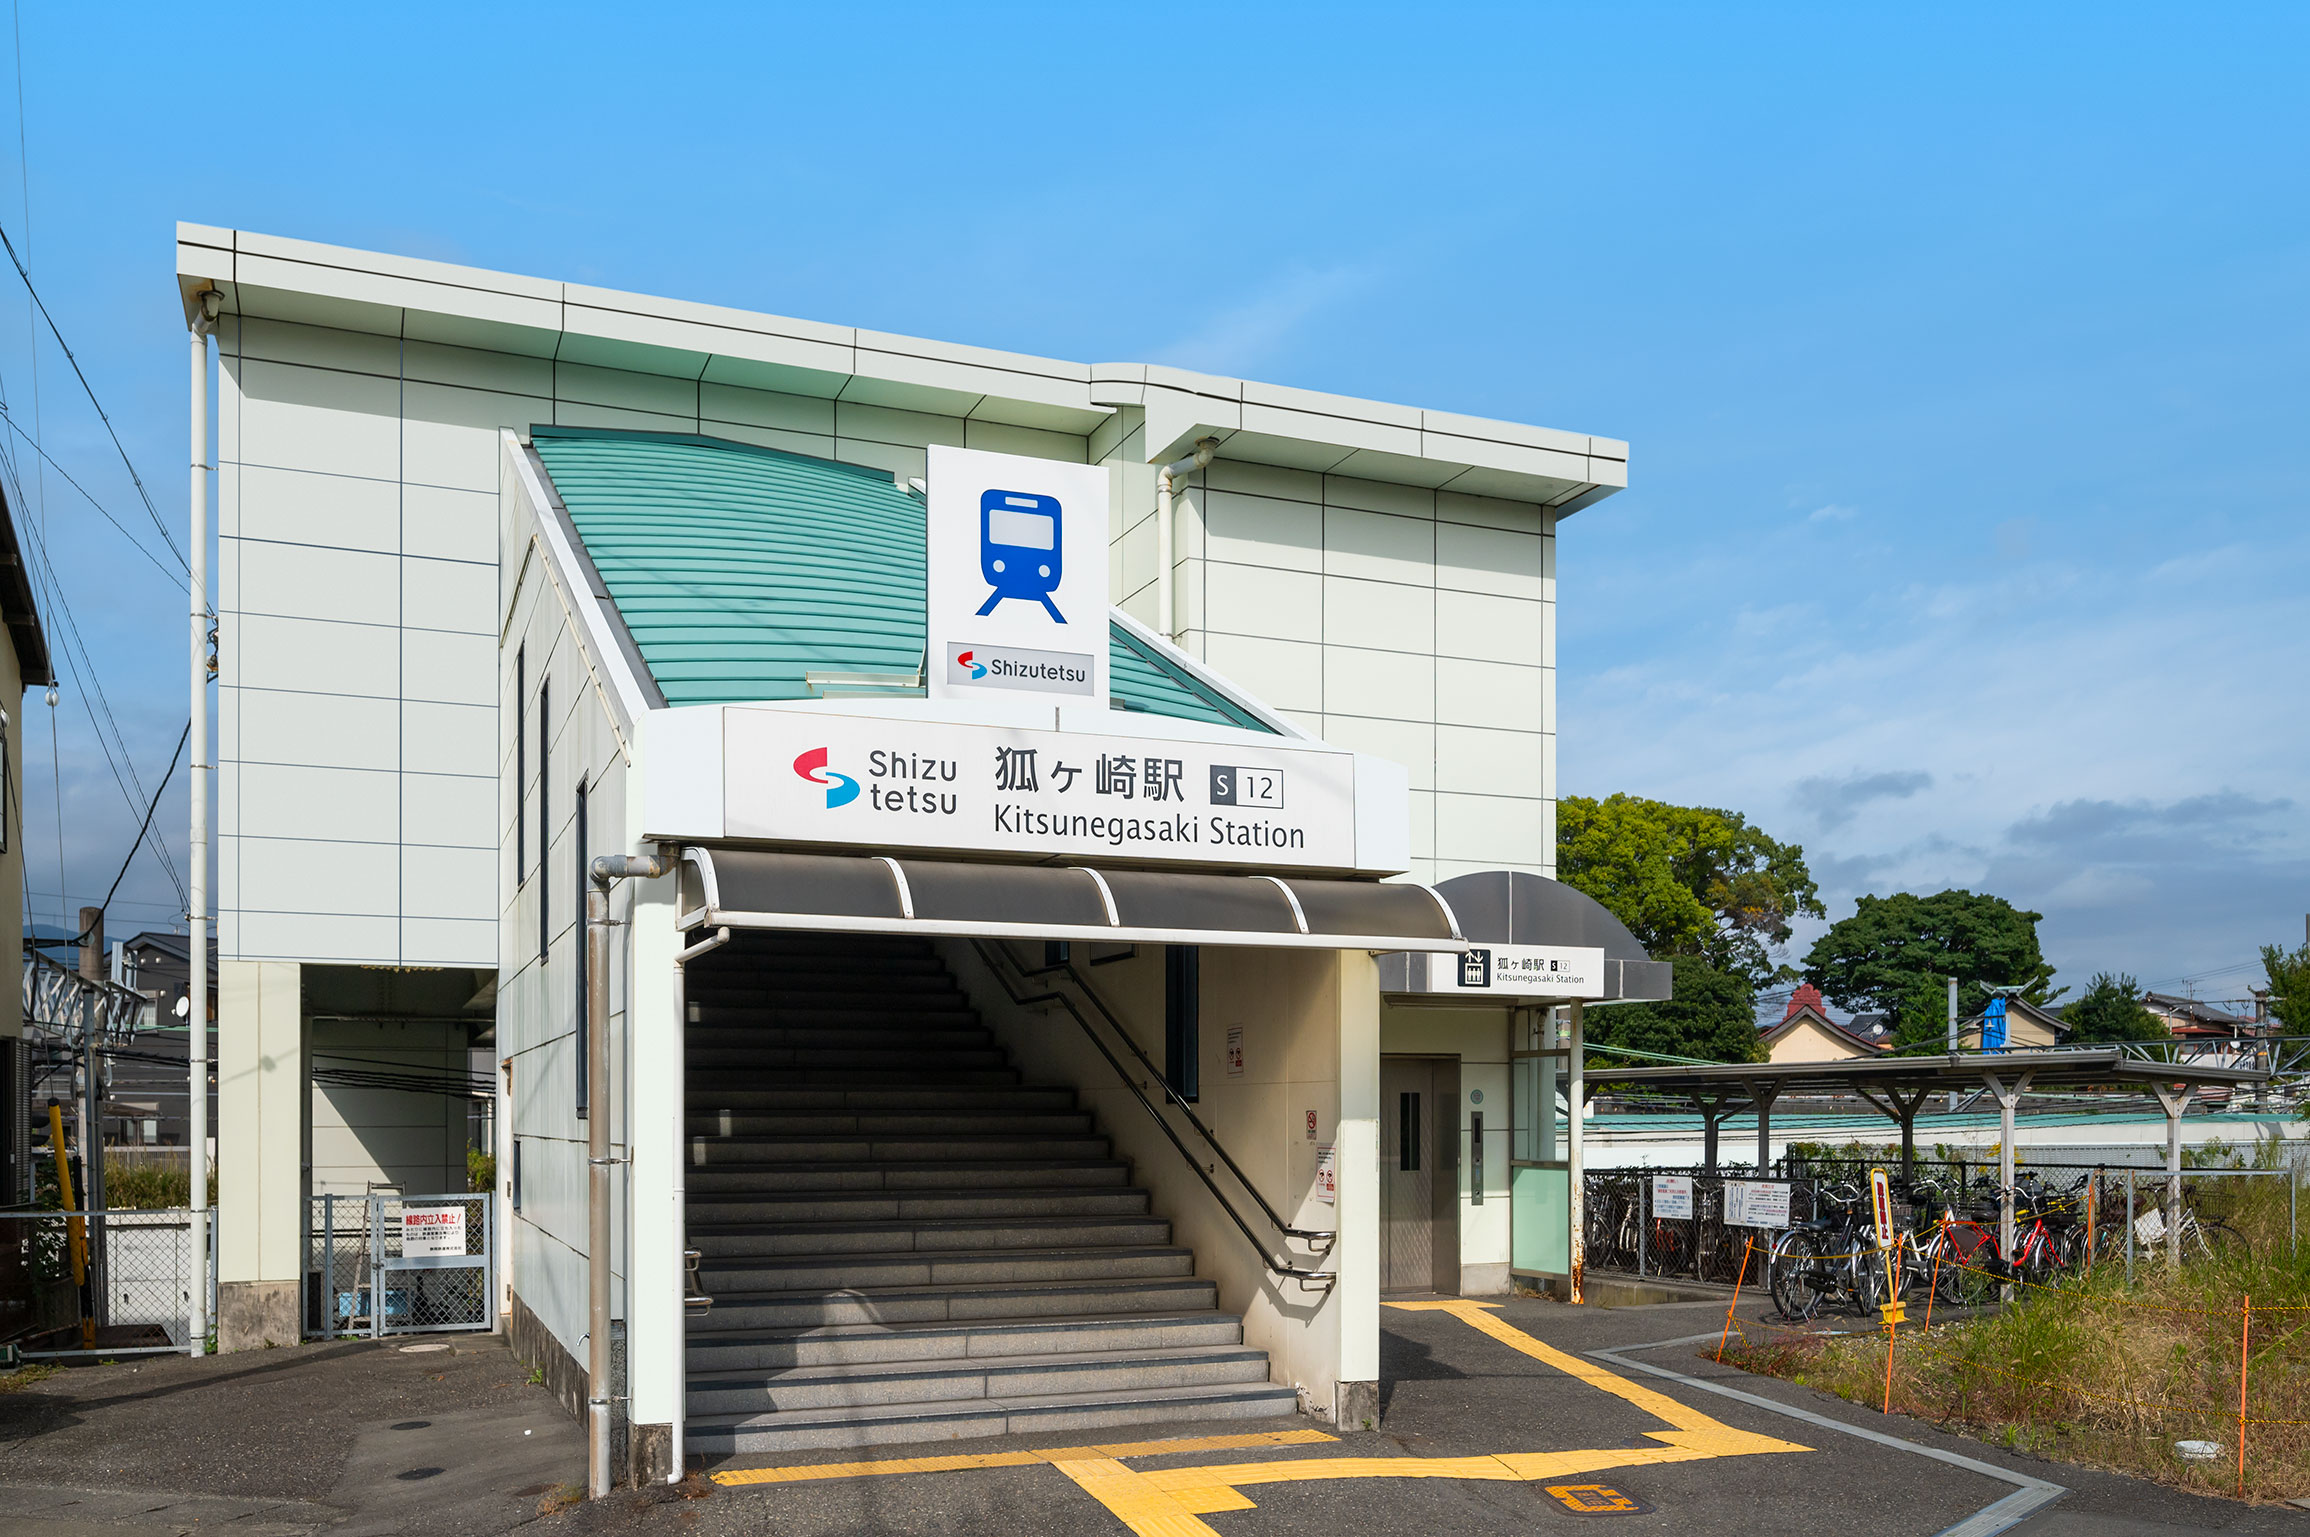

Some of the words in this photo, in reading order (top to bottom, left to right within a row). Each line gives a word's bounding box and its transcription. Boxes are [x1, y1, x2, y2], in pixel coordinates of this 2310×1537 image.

[991, 659, 1085, 682] Shizutetsu
[869, 750, 957, 782] Shizu
[995, 745, 1184, 802] 狐ヶ崎駅
[1246, 776, 1274, 800] 12
[870, 784, 957, 815] tetsu
[994, 804, 1199, 846] Kitsunegasaki
[1210, 816, 1305, 849] Station
[1496, 972, 1554, 984] Kitsunegasaki
[1556, 974, 1585, 984] Station
[1497, 957, 1545, 971] 狐ヶ崎駅
[1559, 962, 1568, 970] 12
